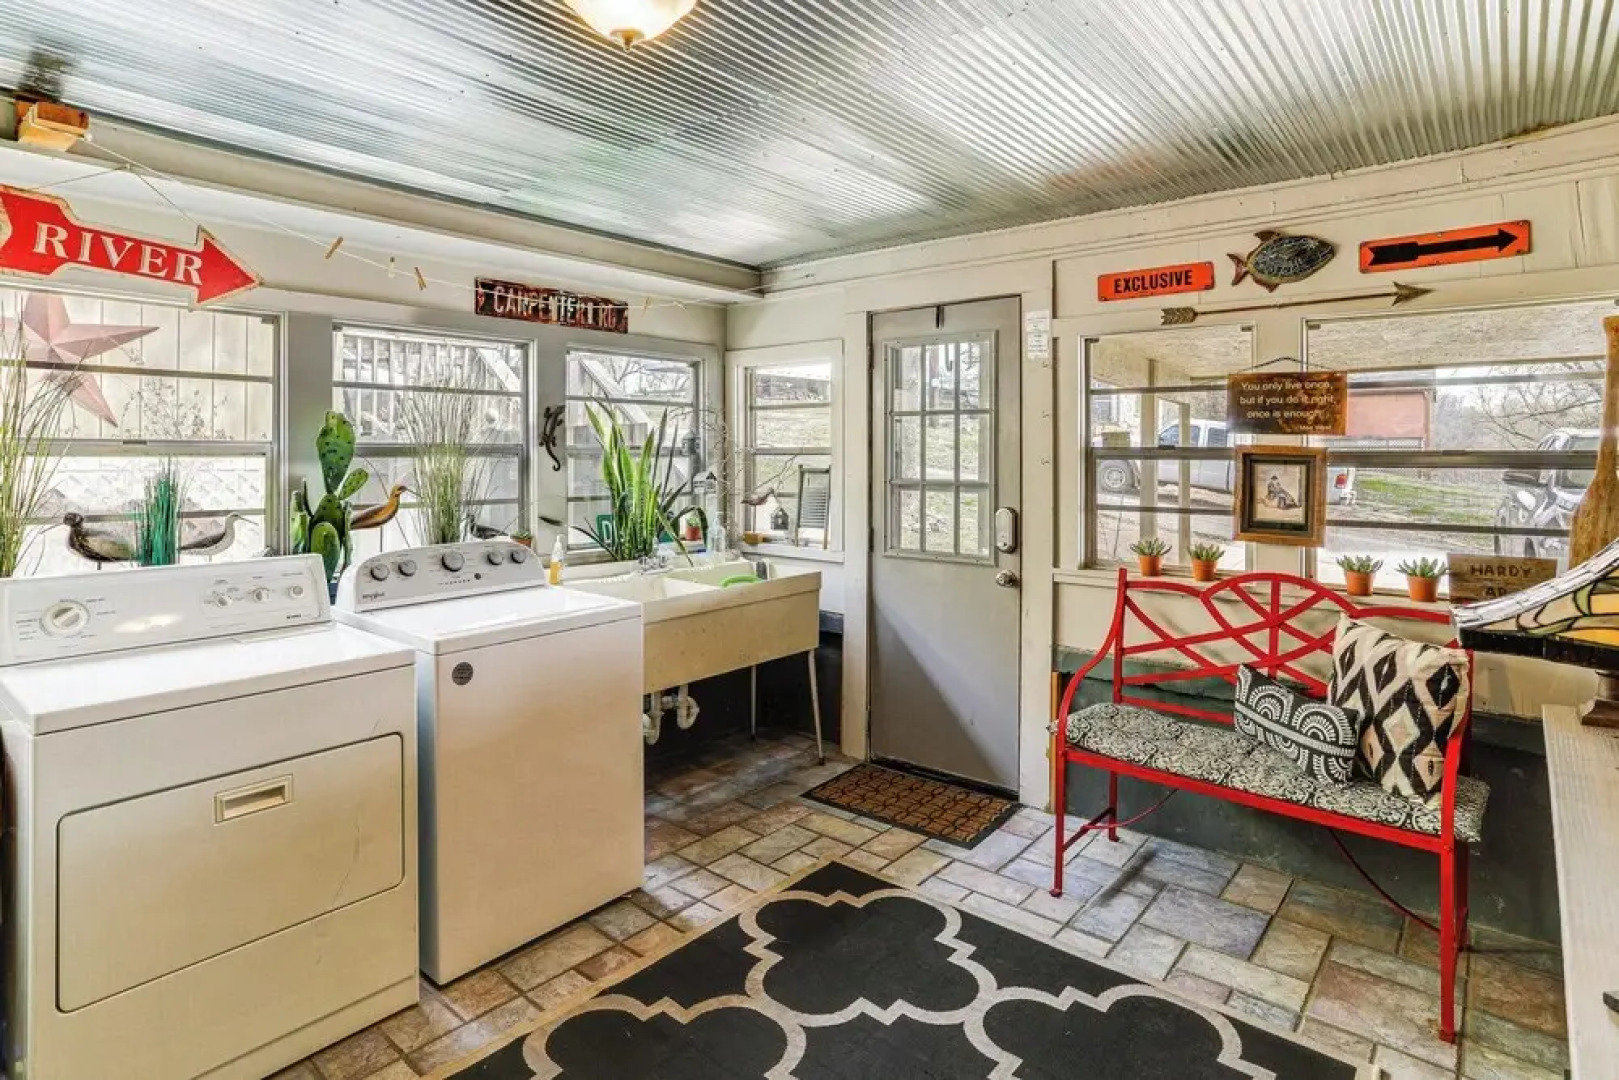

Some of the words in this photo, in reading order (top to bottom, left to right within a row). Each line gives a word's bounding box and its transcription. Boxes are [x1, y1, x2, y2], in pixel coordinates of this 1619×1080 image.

[33, 221, 203, 286] RIVER
[1114, 270, 1193, 294] EXCLUSIVE
[1241, 382, 1260, 391] You
[1263, 381, 1283, 392] only
[1285, 380, 1302, 390] live
[1239, 395, 1256, 404] but
[1257, 395, 1264, 404] if
[1265, 397, 1283, 406] you
[1286, 395, 1299, 404] do
[1246, 410, 1270, 419] once
[1272, 410, 1281, 419] is
[1470, 564, 1532, 578] HARDY
